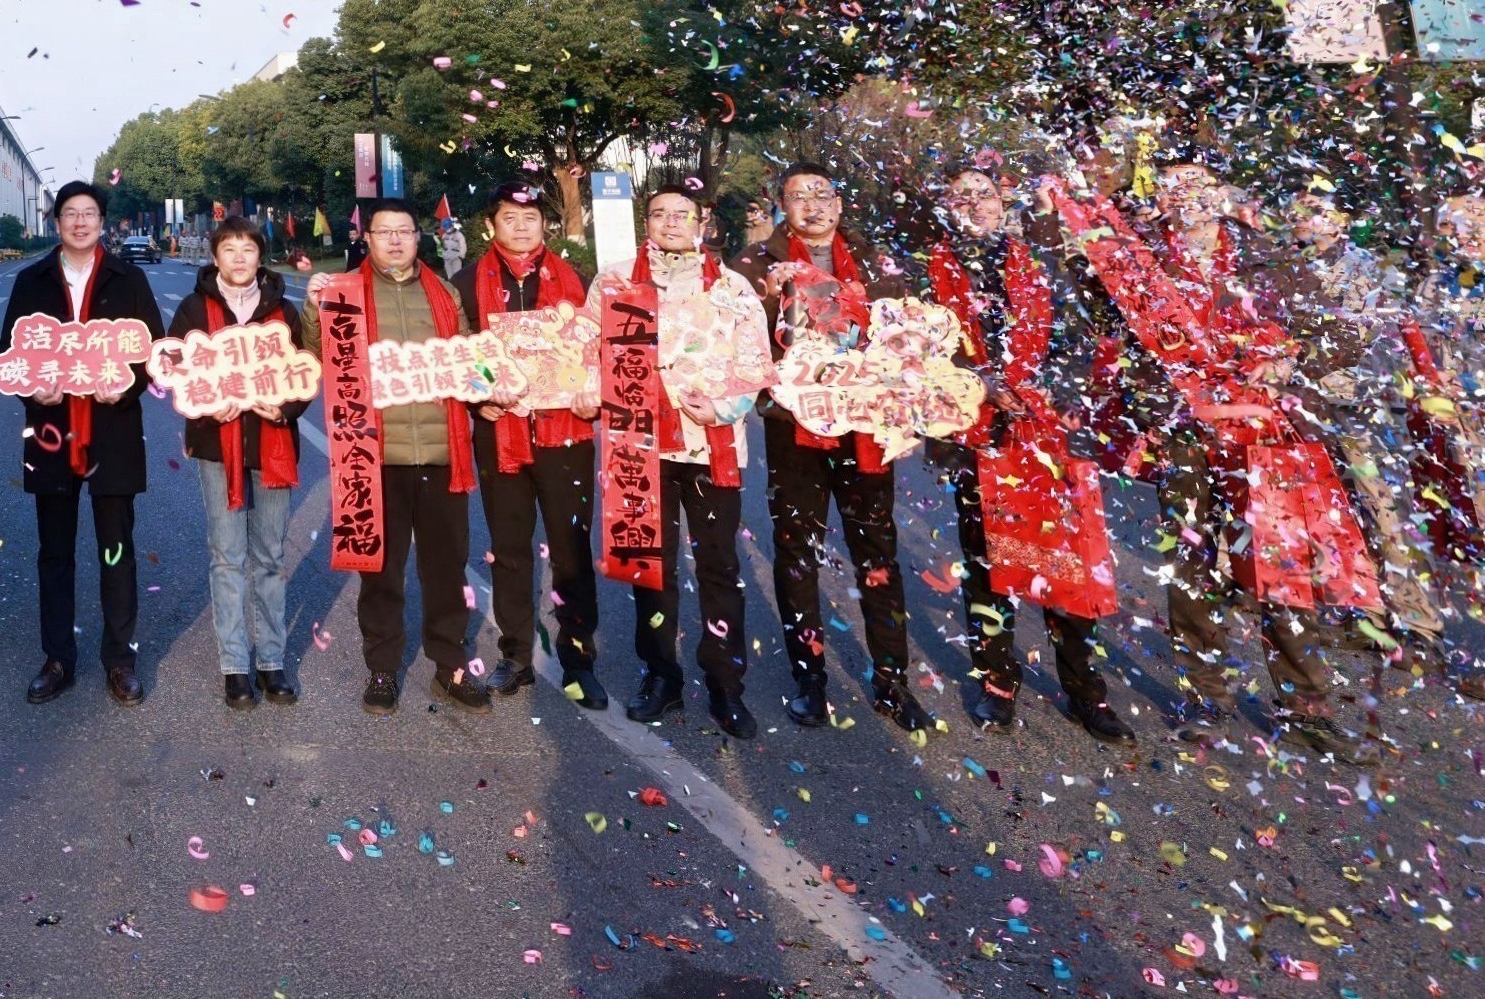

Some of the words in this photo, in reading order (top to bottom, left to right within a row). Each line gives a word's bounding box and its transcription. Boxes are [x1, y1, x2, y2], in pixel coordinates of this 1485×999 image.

[22, 323, 143, 357] 洁尽所能
[371, 339, 499, 374] 技点亮生活
[185, 362, 313, 406] 稳健前行
[791, 360, 882, 387] 2025
